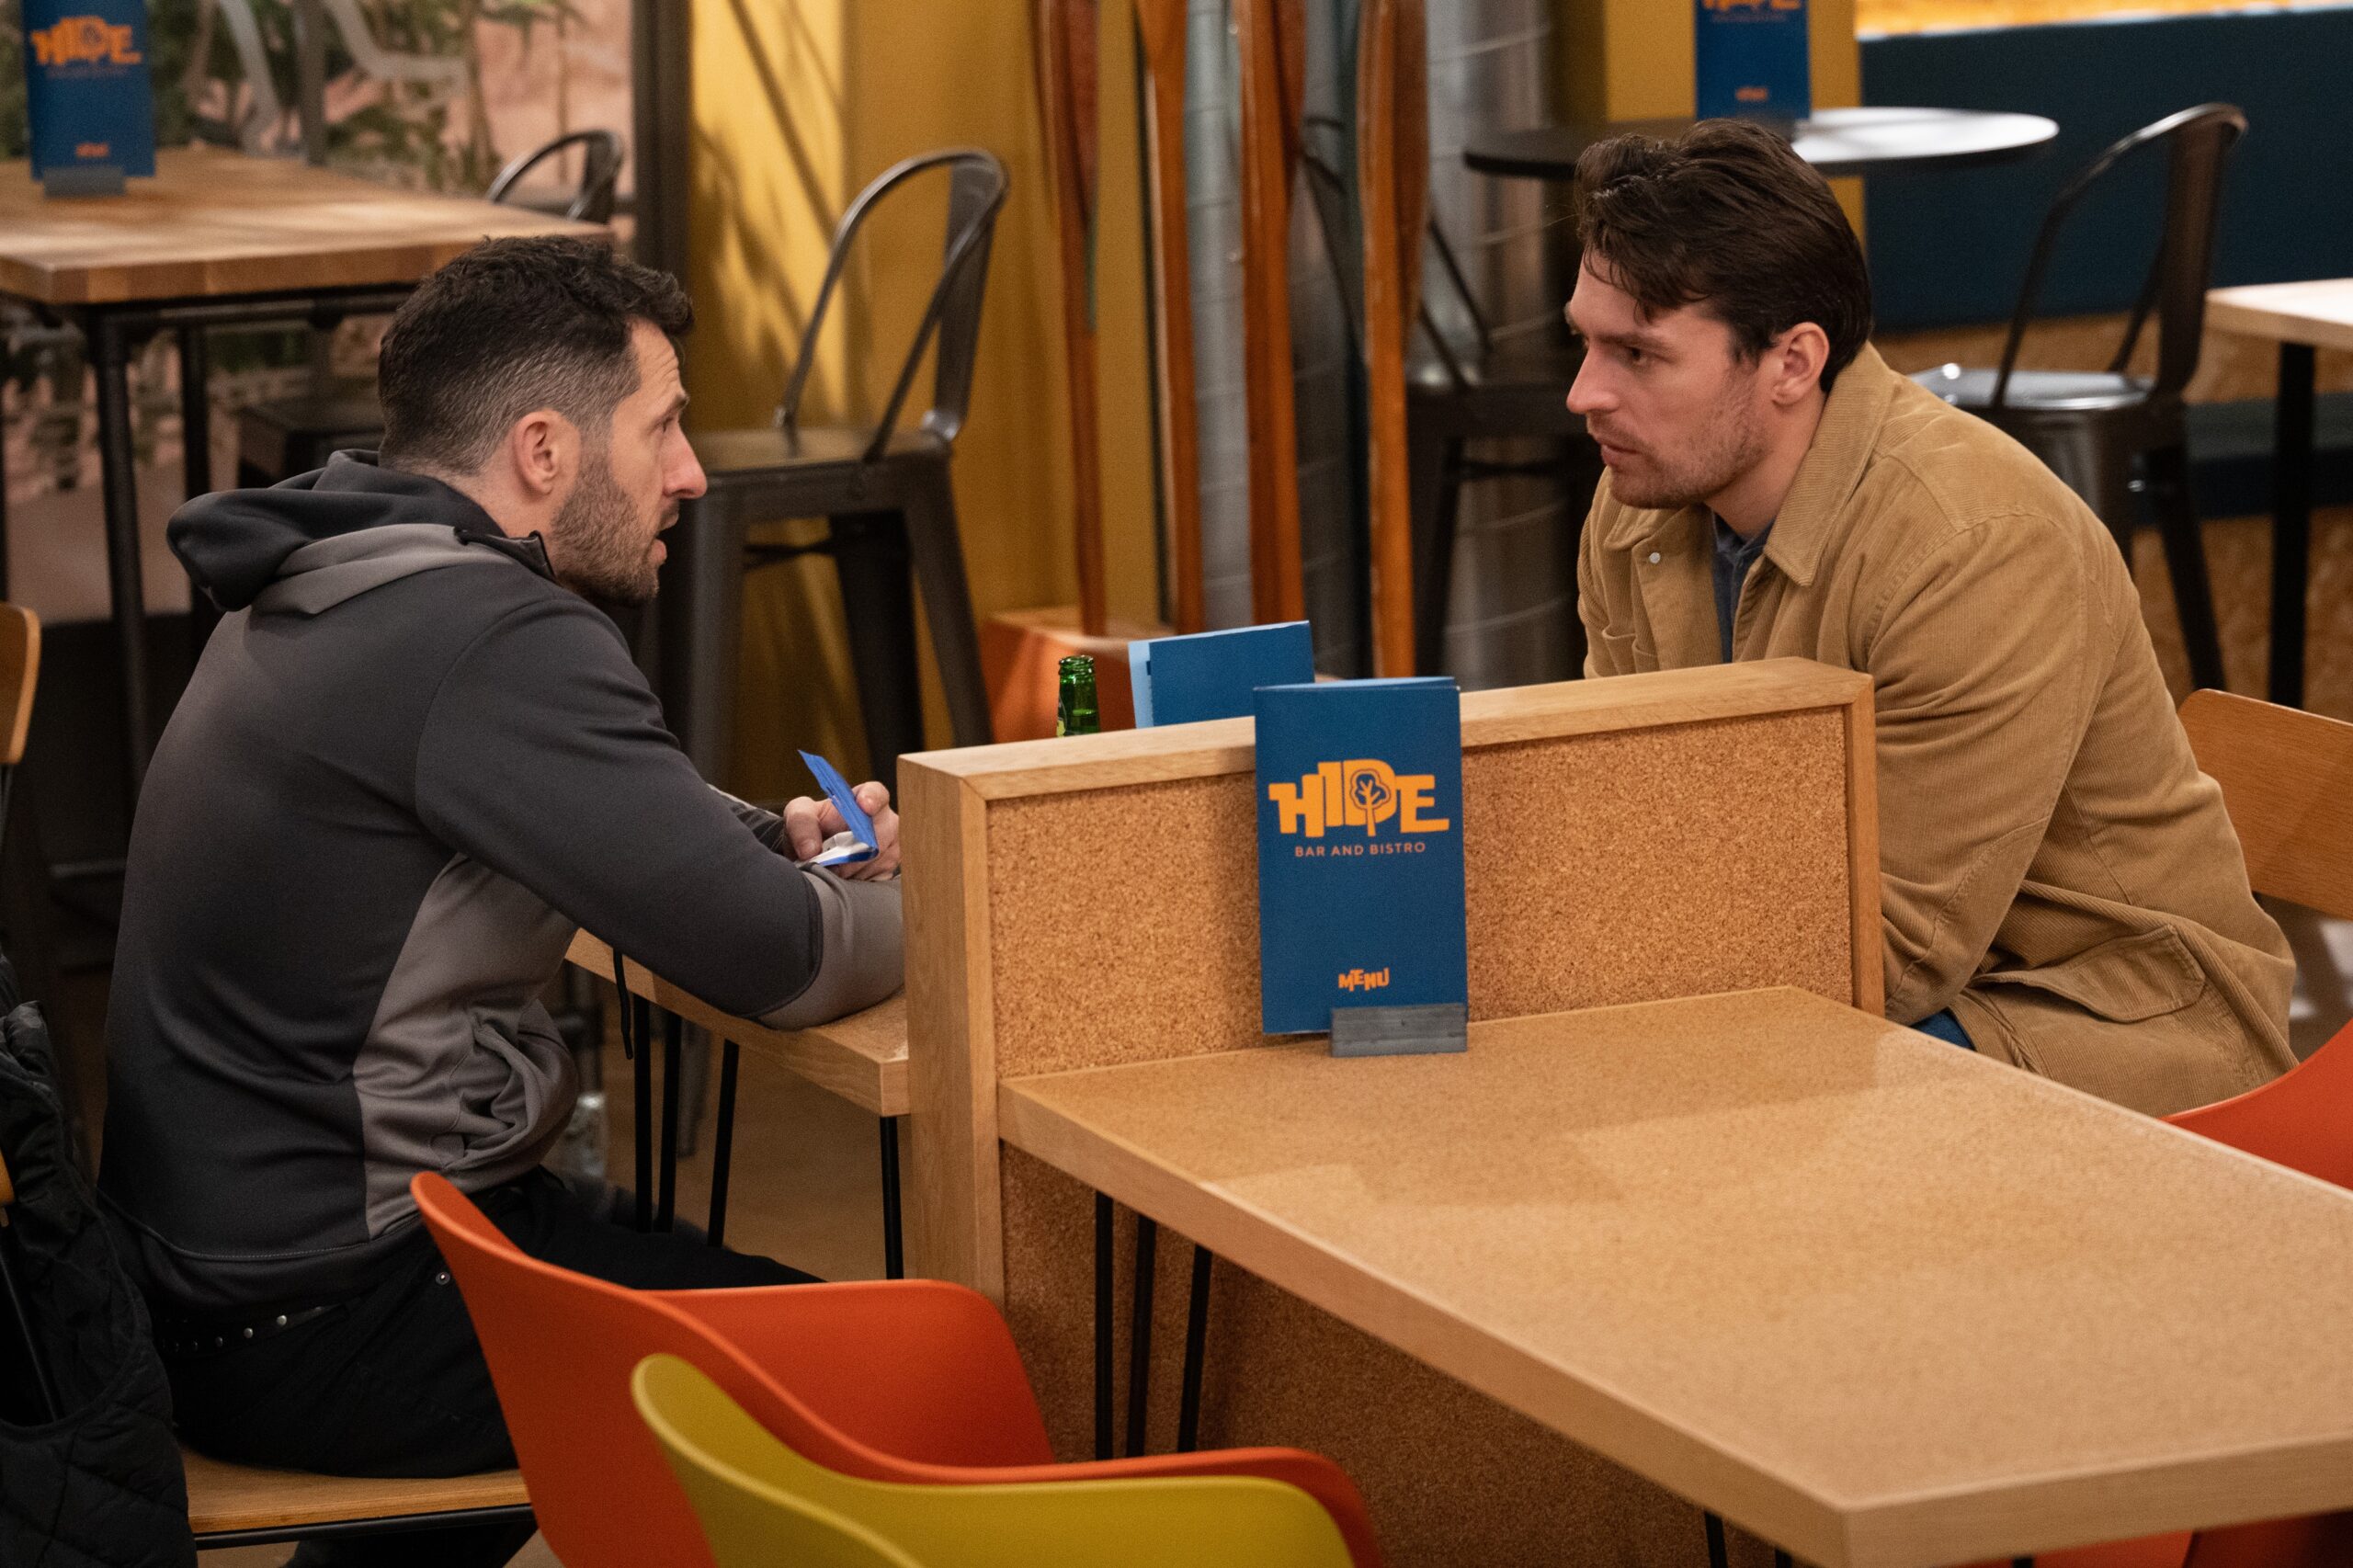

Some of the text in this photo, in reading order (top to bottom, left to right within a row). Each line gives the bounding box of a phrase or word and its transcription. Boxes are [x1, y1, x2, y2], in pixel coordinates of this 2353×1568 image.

[1267, 757, 1450, 838] HIDE
[1295, 841, 1426, 858] BAR AND BISTRO
[1337, 967, 1391, 993] MENU
